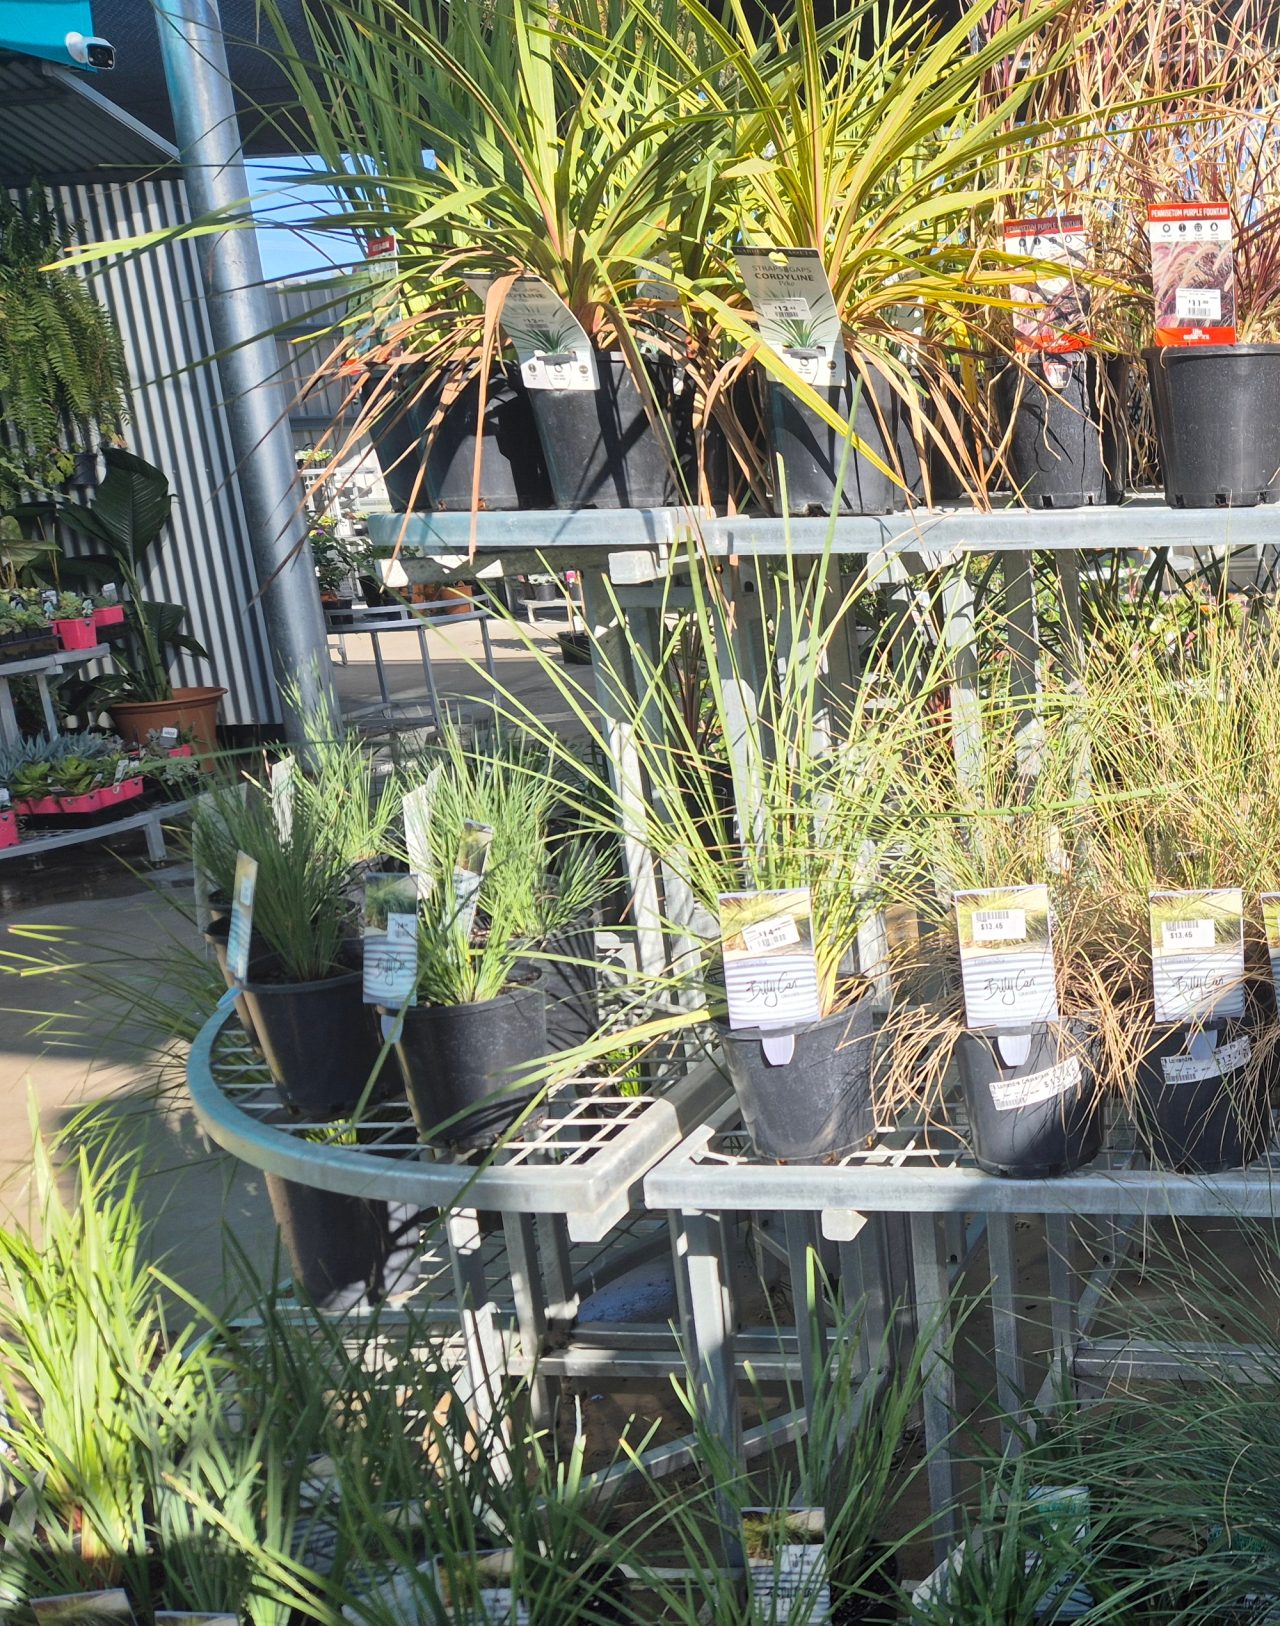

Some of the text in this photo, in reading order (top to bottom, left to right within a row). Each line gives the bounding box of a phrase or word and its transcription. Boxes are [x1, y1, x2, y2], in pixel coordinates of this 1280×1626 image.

[1183, 208, 1203, 217] PURPLE
[1203, 206, 1229, 216] FOUNTAIN
[754, 272, 815, 282] CORDYLINE
[746, 971, 800, 1007] Billy Can
[984, 969, 1036, 1006] Billy Can
